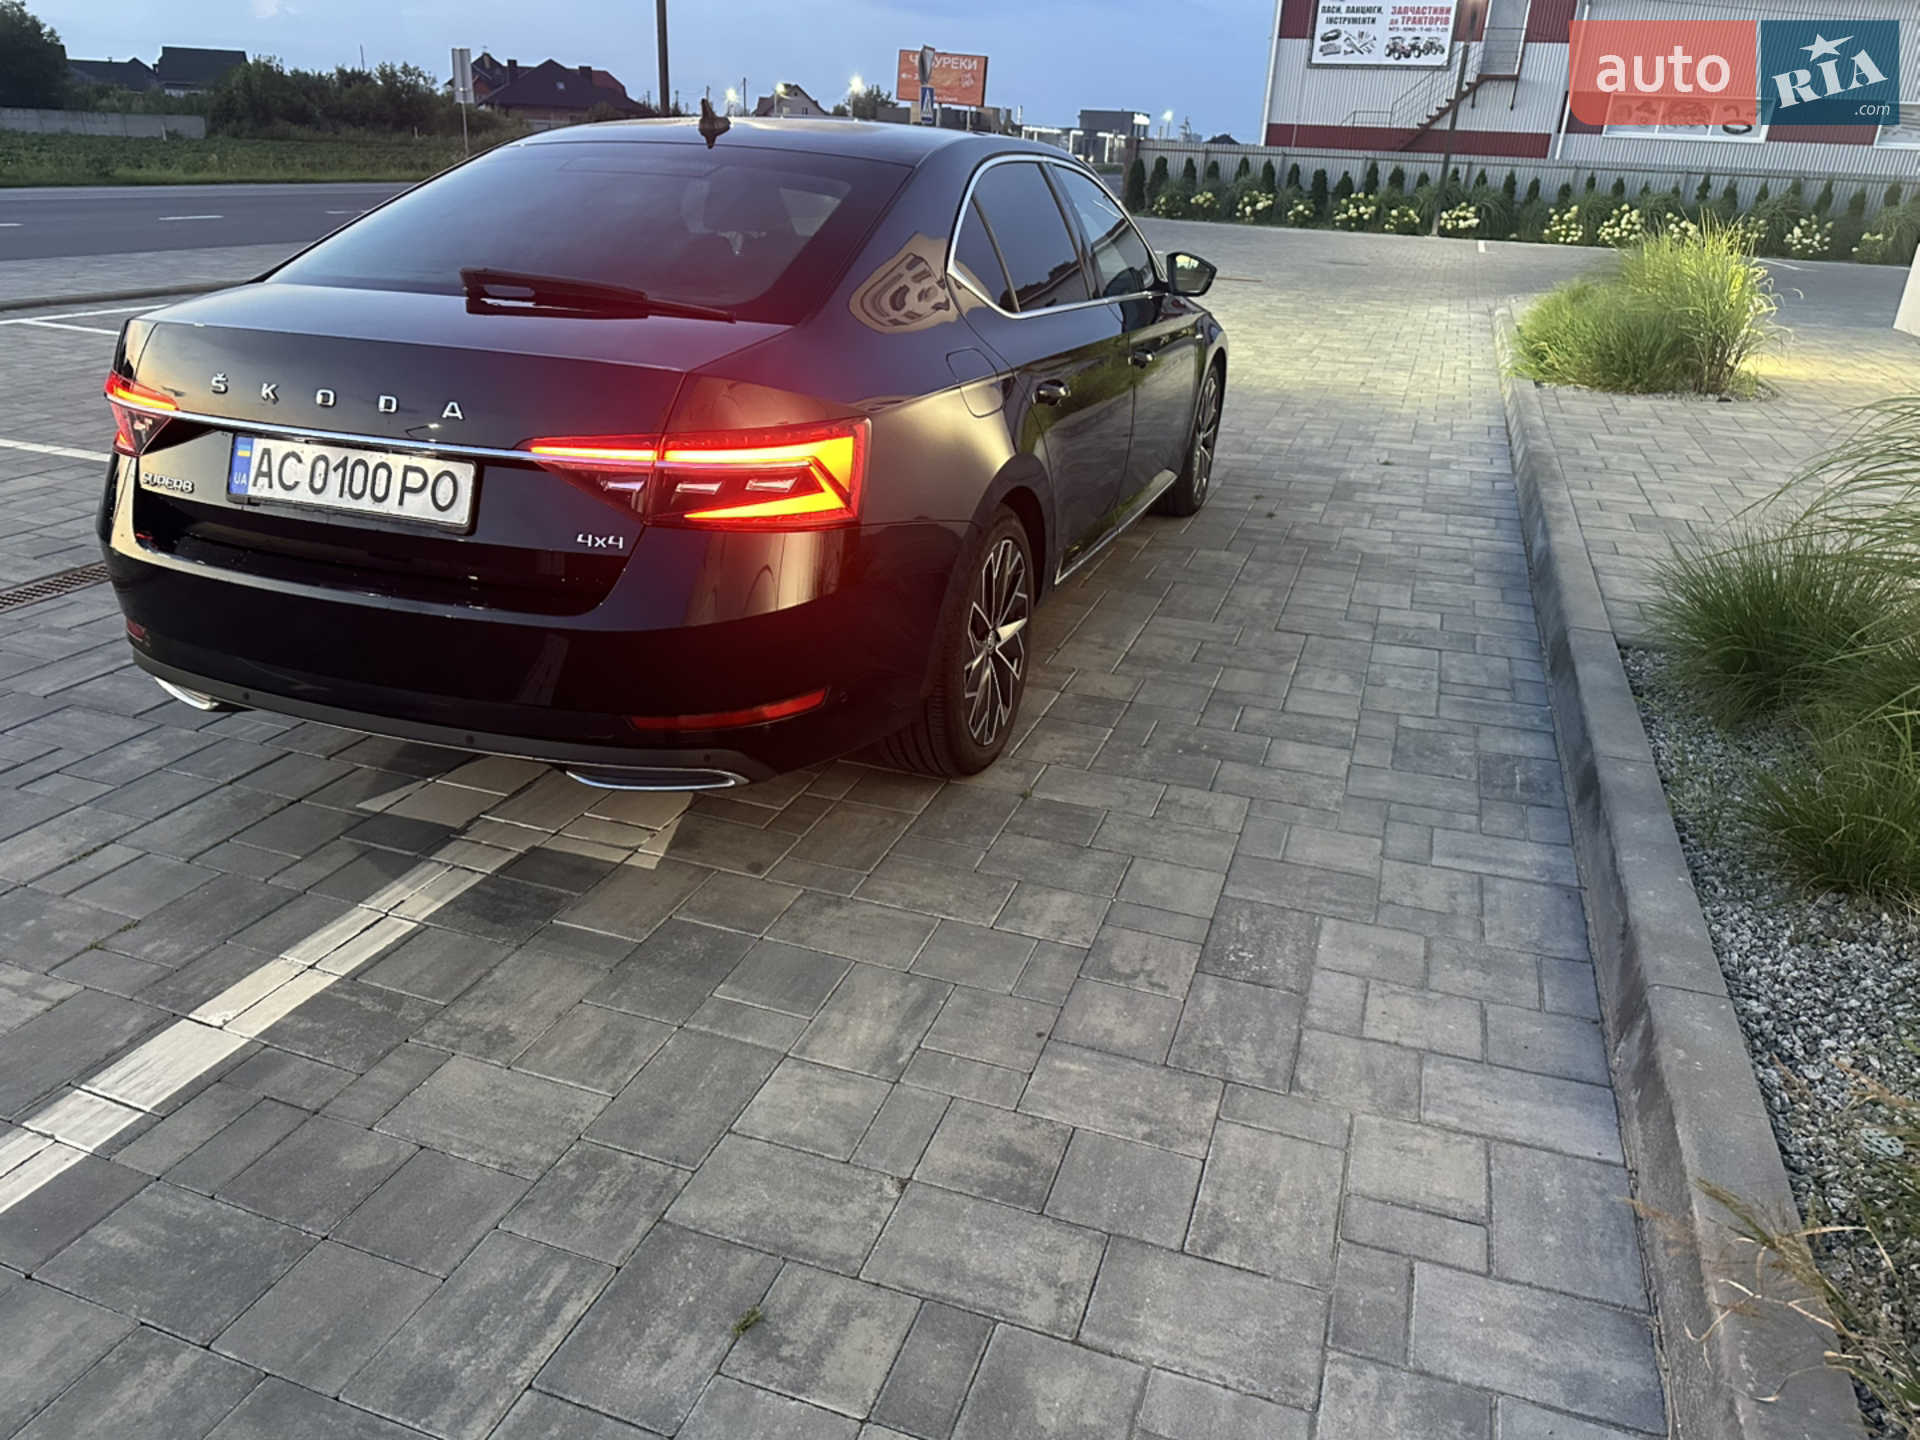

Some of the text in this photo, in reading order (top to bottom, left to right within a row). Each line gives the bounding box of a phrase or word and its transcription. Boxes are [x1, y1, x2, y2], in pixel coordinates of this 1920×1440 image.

[1345, 5, 1384, 15] ЛАНЦЮГИ,
[1391, 6, 1452, 15] ЗАПЧАСТИНИ
[1325, 16, 1377, 25] ІНСТРУМЕНТИ
[1401, 16, 1450, 25] ТРАКТОРІВ
[909, 54, 978, 71] ЧУРЕКИ
[210, 372, 465, 421] ŠKODA
[142, 471, 195, 494] SUPERB
[233, 471, 248, 486] UA
[576, 533, 624, 550] 4x4
